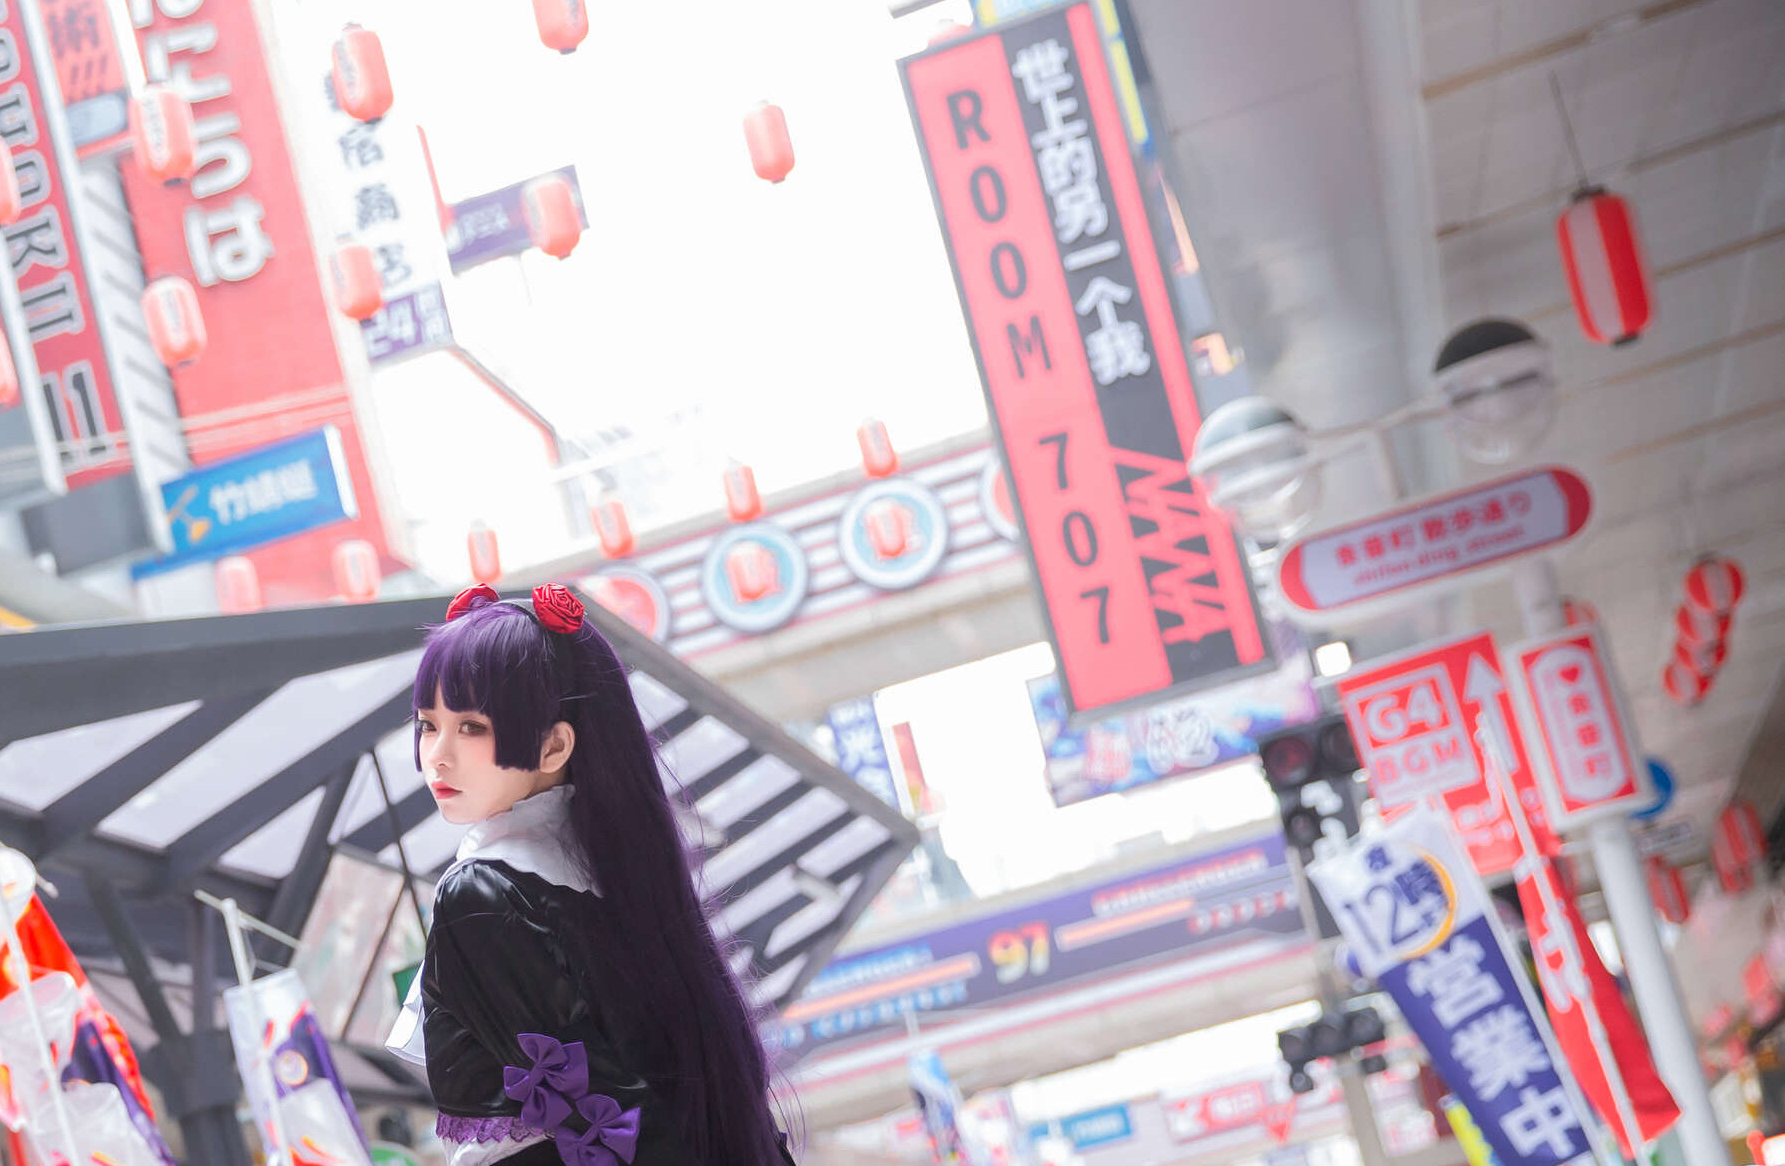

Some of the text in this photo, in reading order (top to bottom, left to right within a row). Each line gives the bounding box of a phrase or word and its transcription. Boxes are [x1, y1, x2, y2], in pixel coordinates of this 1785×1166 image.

[945, 89, 1053, 379] ROOM
[1038, 432, 1112, 645] 707
[988, 920, 1052, 984] 97
[1407, 933, 1581, 1159] 営業中
